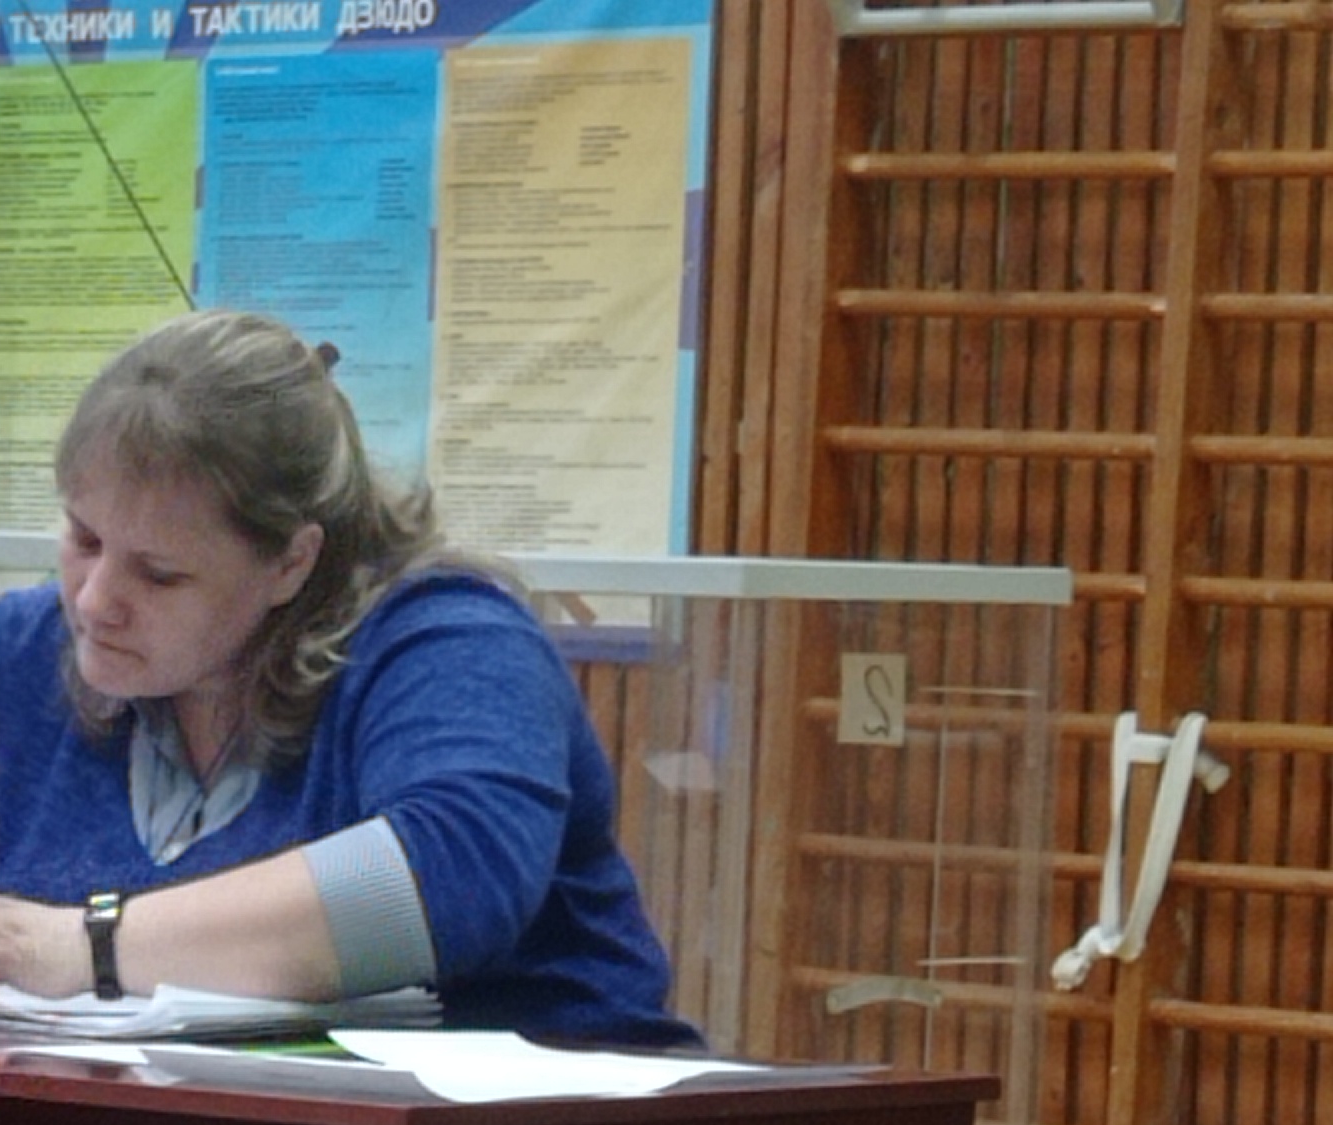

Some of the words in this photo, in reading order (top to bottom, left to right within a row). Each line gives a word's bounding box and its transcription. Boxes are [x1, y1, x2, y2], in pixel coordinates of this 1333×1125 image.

[8, 10, 136, 44] ТЕХНИКИ
[150, 10, 174, 39] И
[188, 3, 320, 38] ТАКТИКИ
[336, 0, 435, 35] ДЗЮДО
